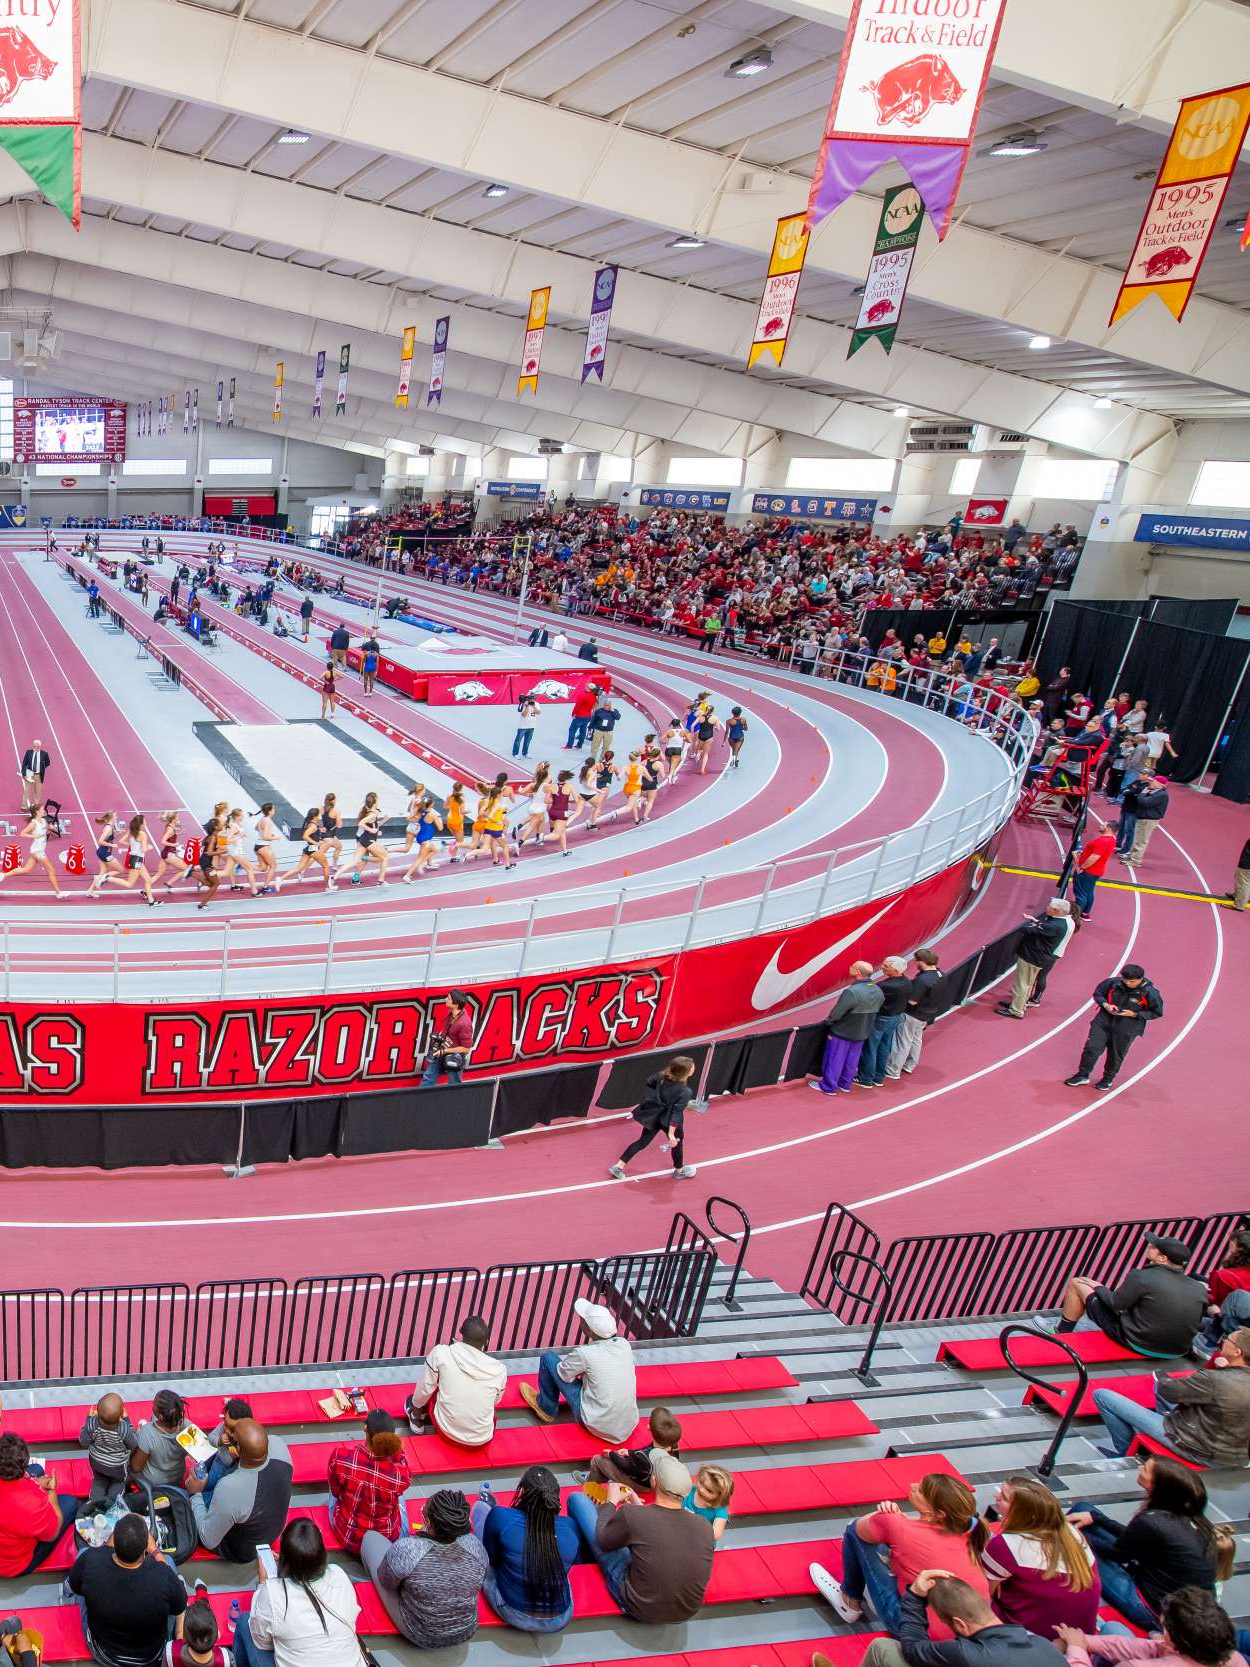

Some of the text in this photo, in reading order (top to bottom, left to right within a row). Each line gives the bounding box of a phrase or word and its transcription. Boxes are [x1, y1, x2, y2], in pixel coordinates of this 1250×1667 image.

[864, 18, 988, 47] Track & Field
[1156, 182, 1218, 212] 1995
[886, 202, 919, 221] NCAA
[1166, 208, 1194, 221] Men's
[1145, 218, 1209, 237] Outdoor
[1142, 235, 1168, 248] Track
[1176, 230, 1205, 244] Field
[873, 251, 910, 274] 1995
[769, 275, 797, 293] 1996
[1152, 524, 1248, 539] SOUTHEASTERN
[4, 853, 12, 869] 5
[68, 855, 76, 870] 6
[186, 847, 194, 861] 8
